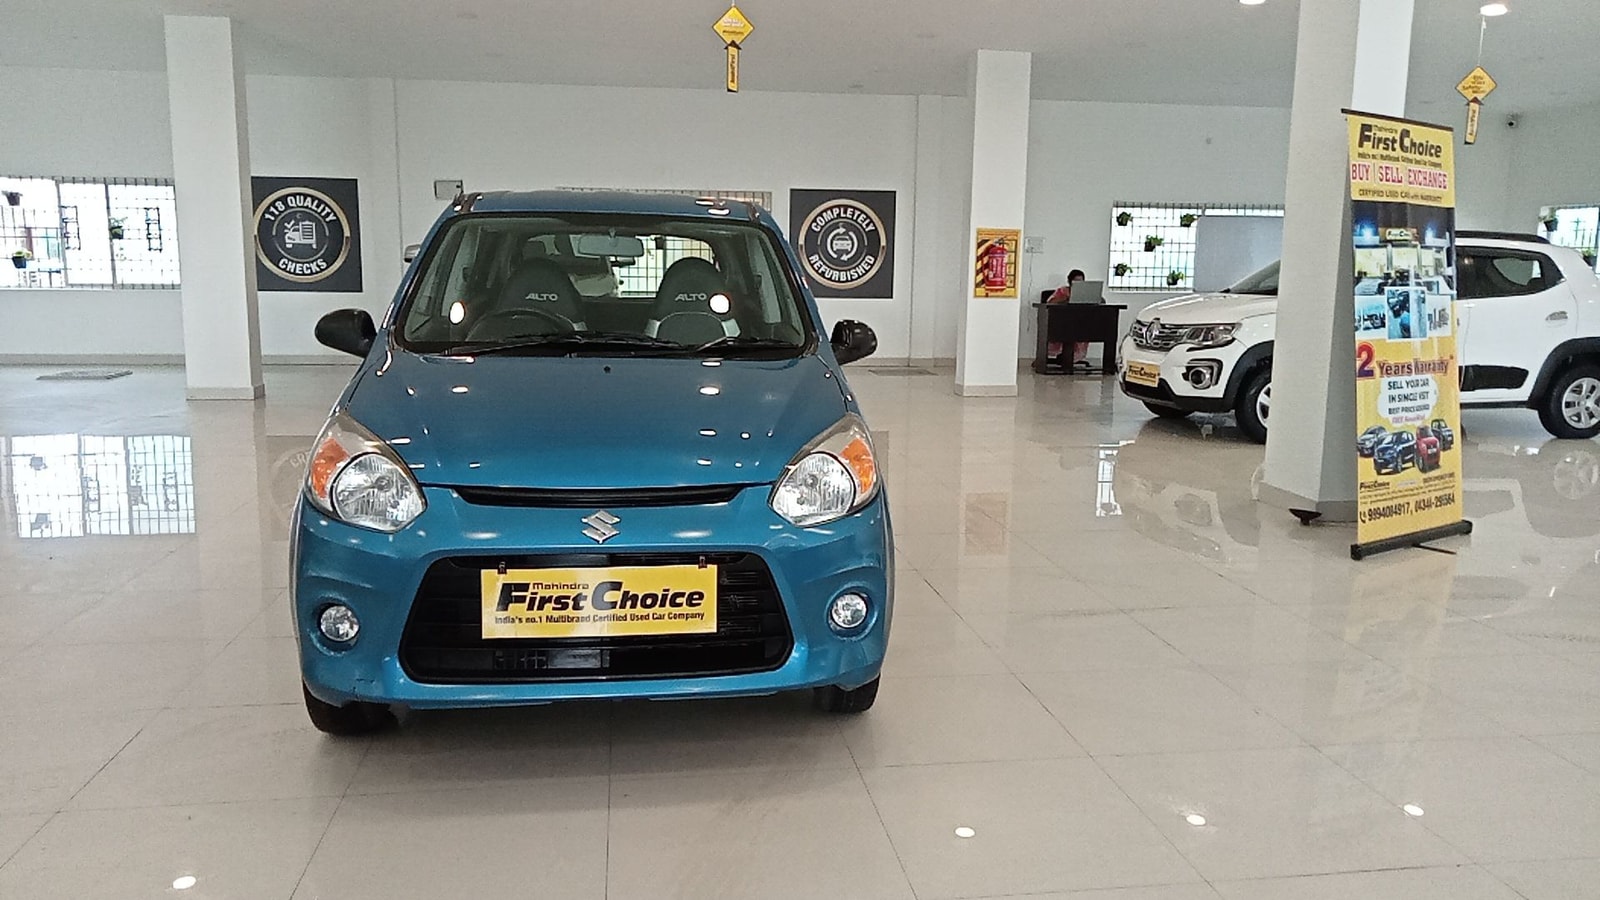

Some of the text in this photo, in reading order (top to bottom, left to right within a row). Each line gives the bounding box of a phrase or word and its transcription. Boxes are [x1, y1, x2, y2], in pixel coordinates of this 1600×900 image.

[1358, 123, 1442, 158] First Choice
[1351, 164, 1447, 190] BUY SELL EXCHANGE
[264, 195, 337, 223] 118 QUALITY
[811, 207, 876, 232] COMPLETELY
[279, 258, 327, 274] CHECKS
[809, 254, 875, 281] REFURBISHED
[526, 292, 558, 301] ALTO
[675, 292, 707, 301] ALTO
[1357, 342, 1374, 378] 2
[1378, 360, 1413, 376] Years
[1388, 380, 1404, 390] SELL
[1388, 394, 1396, 403] IN
[532, 582, 589, 590] Mahindra
[496, 581, 705, 612] First Choice
[495, 611, 705, 625] India's no.1 Multibrand Certified Used Car Company
